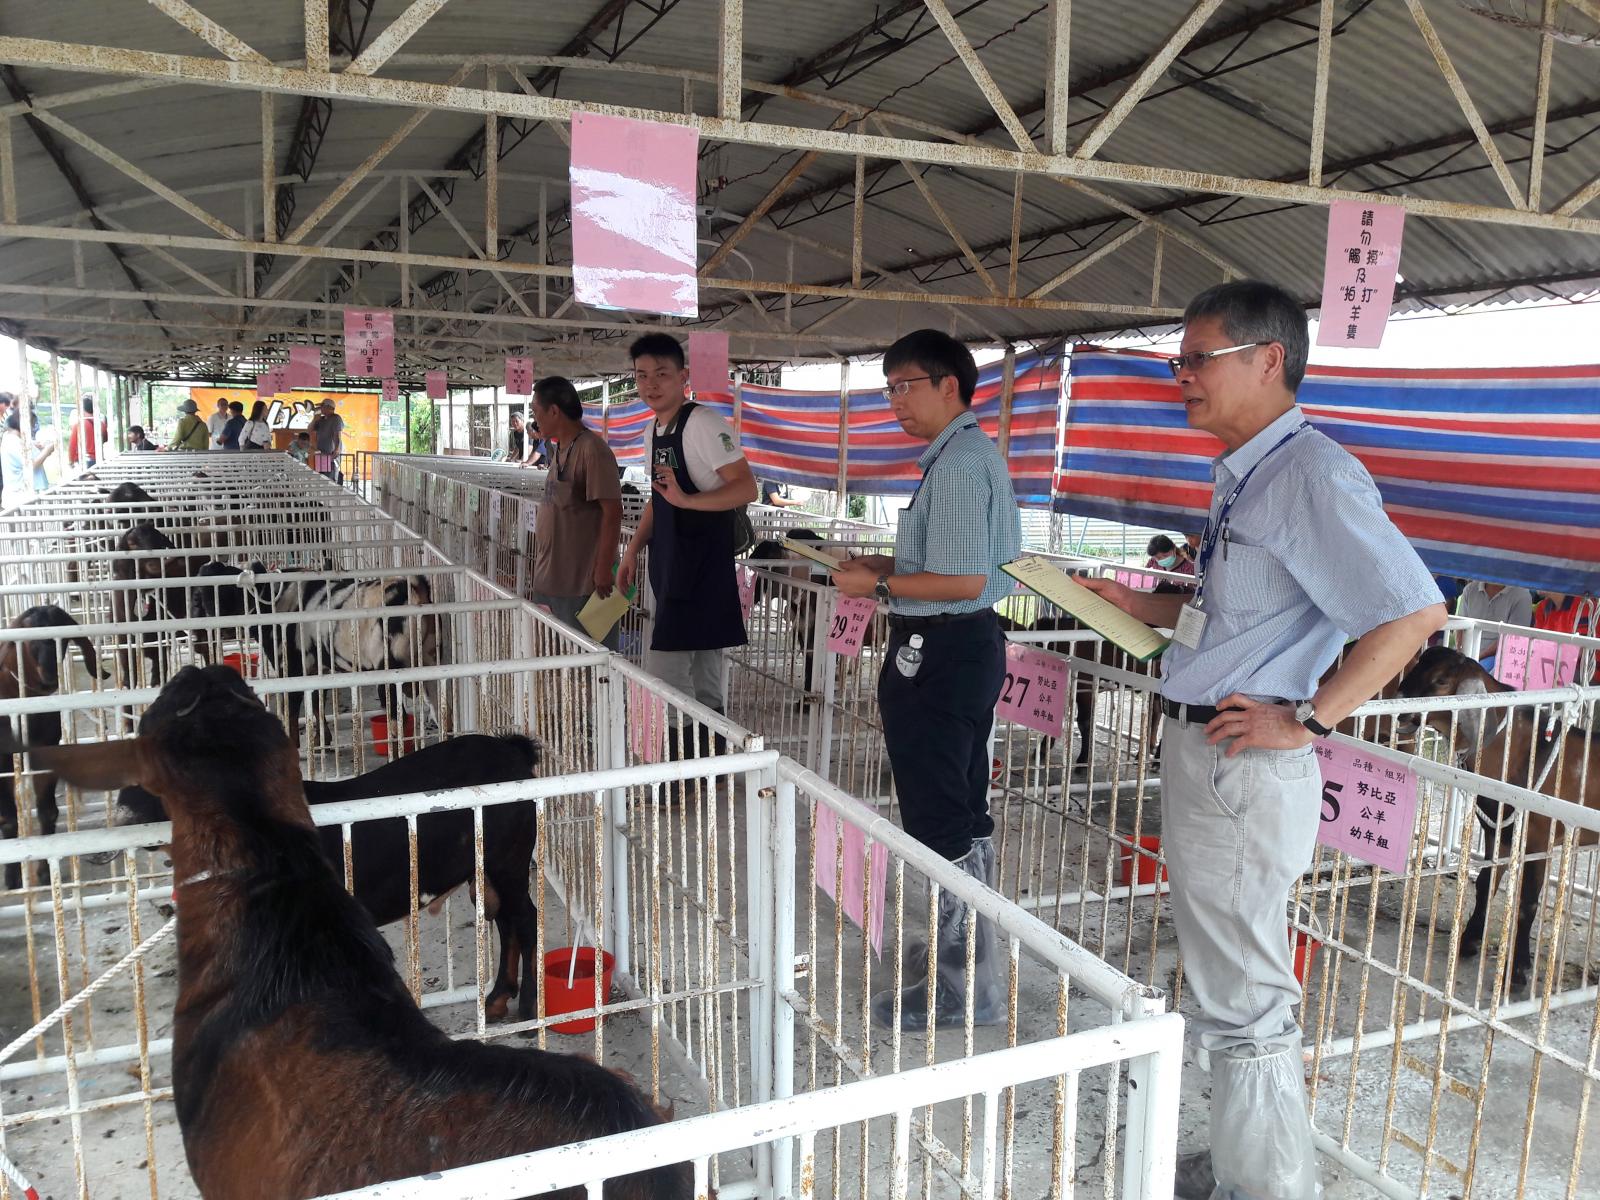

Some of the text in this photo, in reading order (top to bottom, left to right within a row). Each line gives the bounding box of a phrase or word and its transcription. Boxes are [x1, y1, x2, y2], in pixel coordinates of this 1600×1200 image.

[830, 614, 848, 640] 29
[1001, 672, 1031, 708] 27
[1356, 780, 1397, 806] 努比亞
[1360, 806, 1387, 825] 公羊
[1350, 825, 1390, 850] 幼年組
